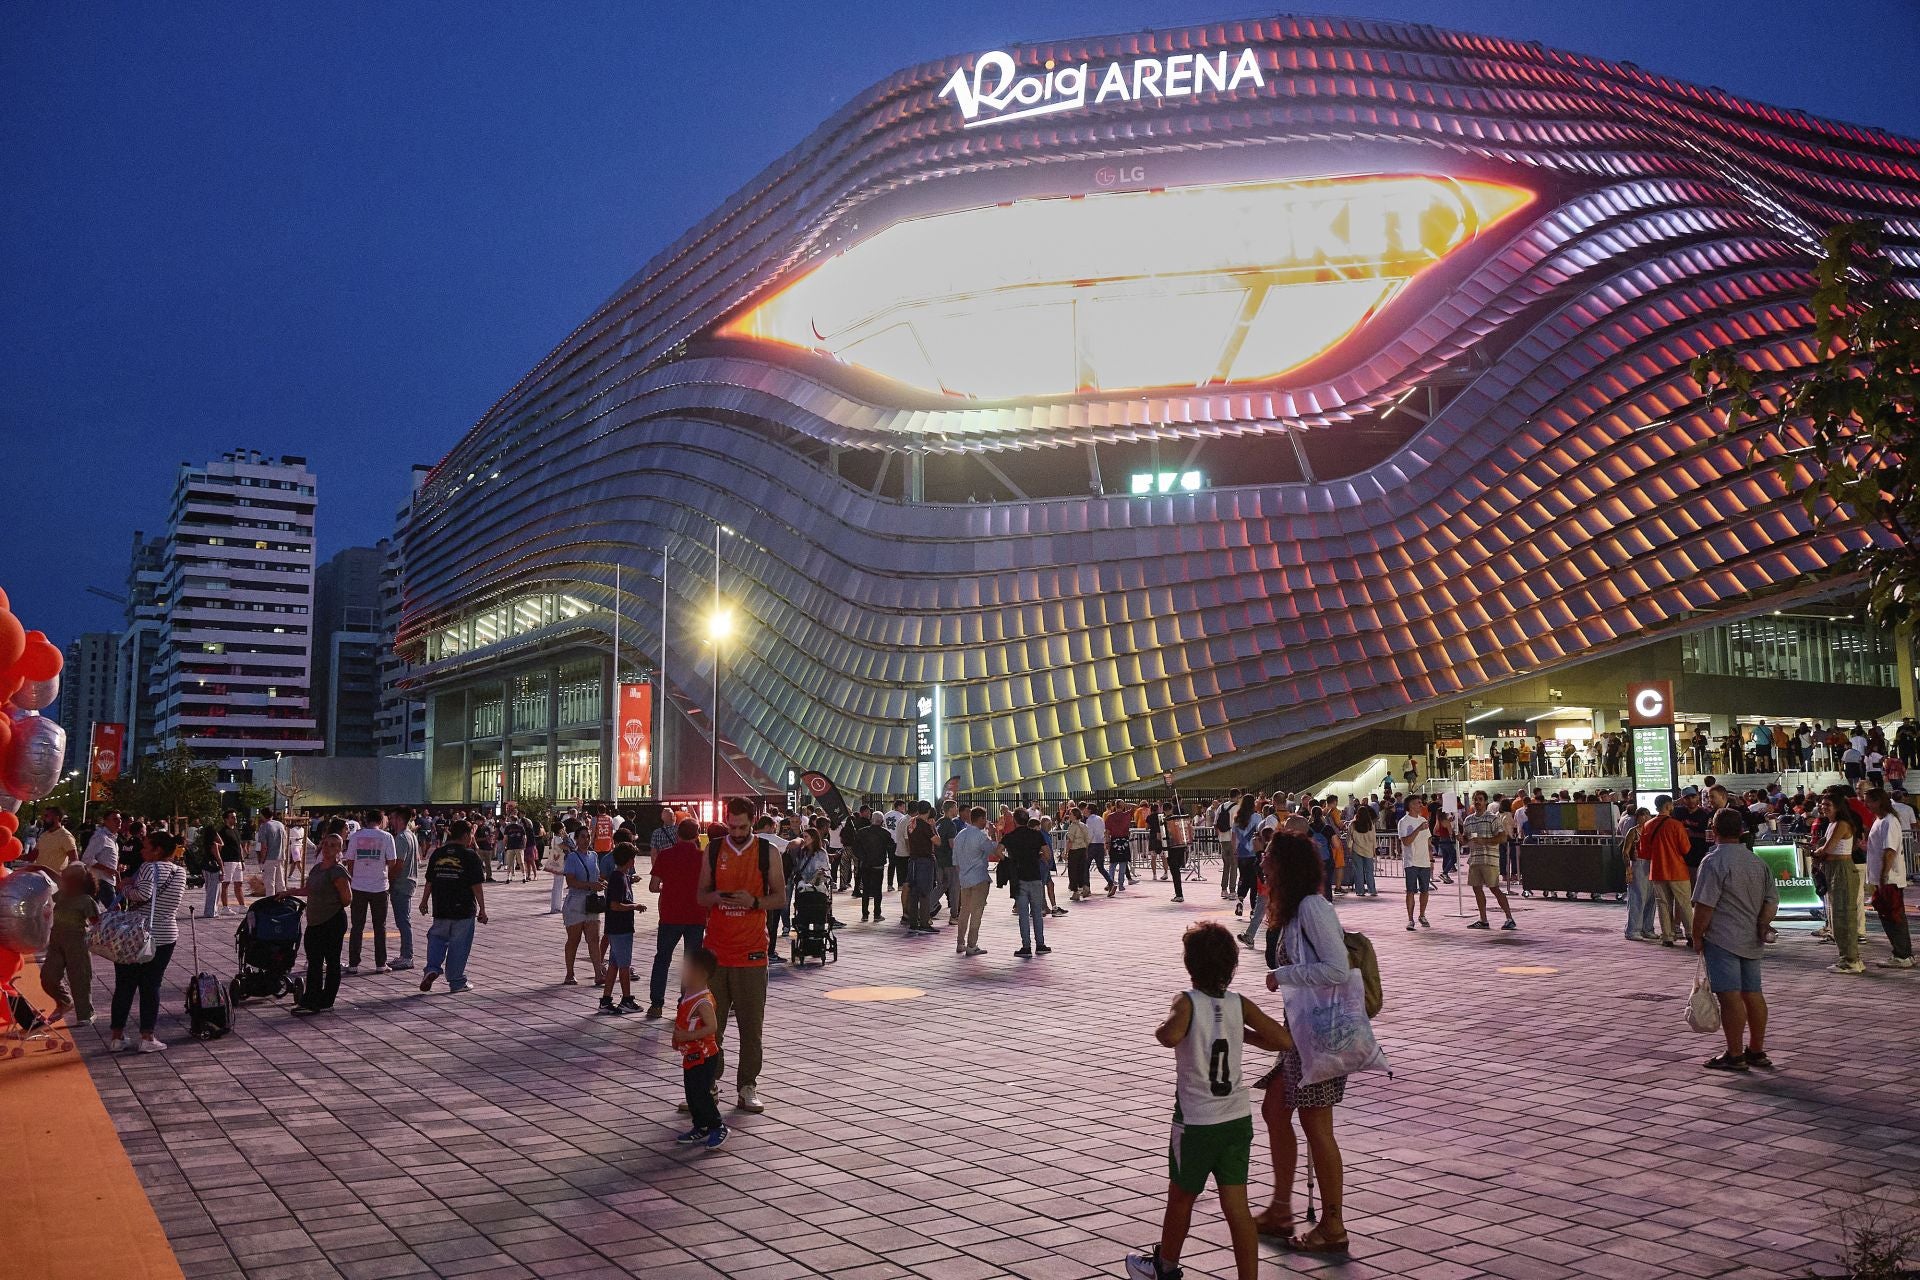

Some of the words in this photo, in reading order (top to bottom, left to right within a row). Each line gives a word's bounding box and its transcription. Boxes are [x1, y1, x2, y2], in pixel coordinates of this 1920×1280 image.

[938, 50, 1088, 127] Roig
[1094, 47, 1265, 104] ARENA
[1119, 166, 1145, 183] LG
[1635, 689, 1663, 717] C
[1774, 876, 1815, 888] ineken
[1209, 1038, 1232, 1096] 0
